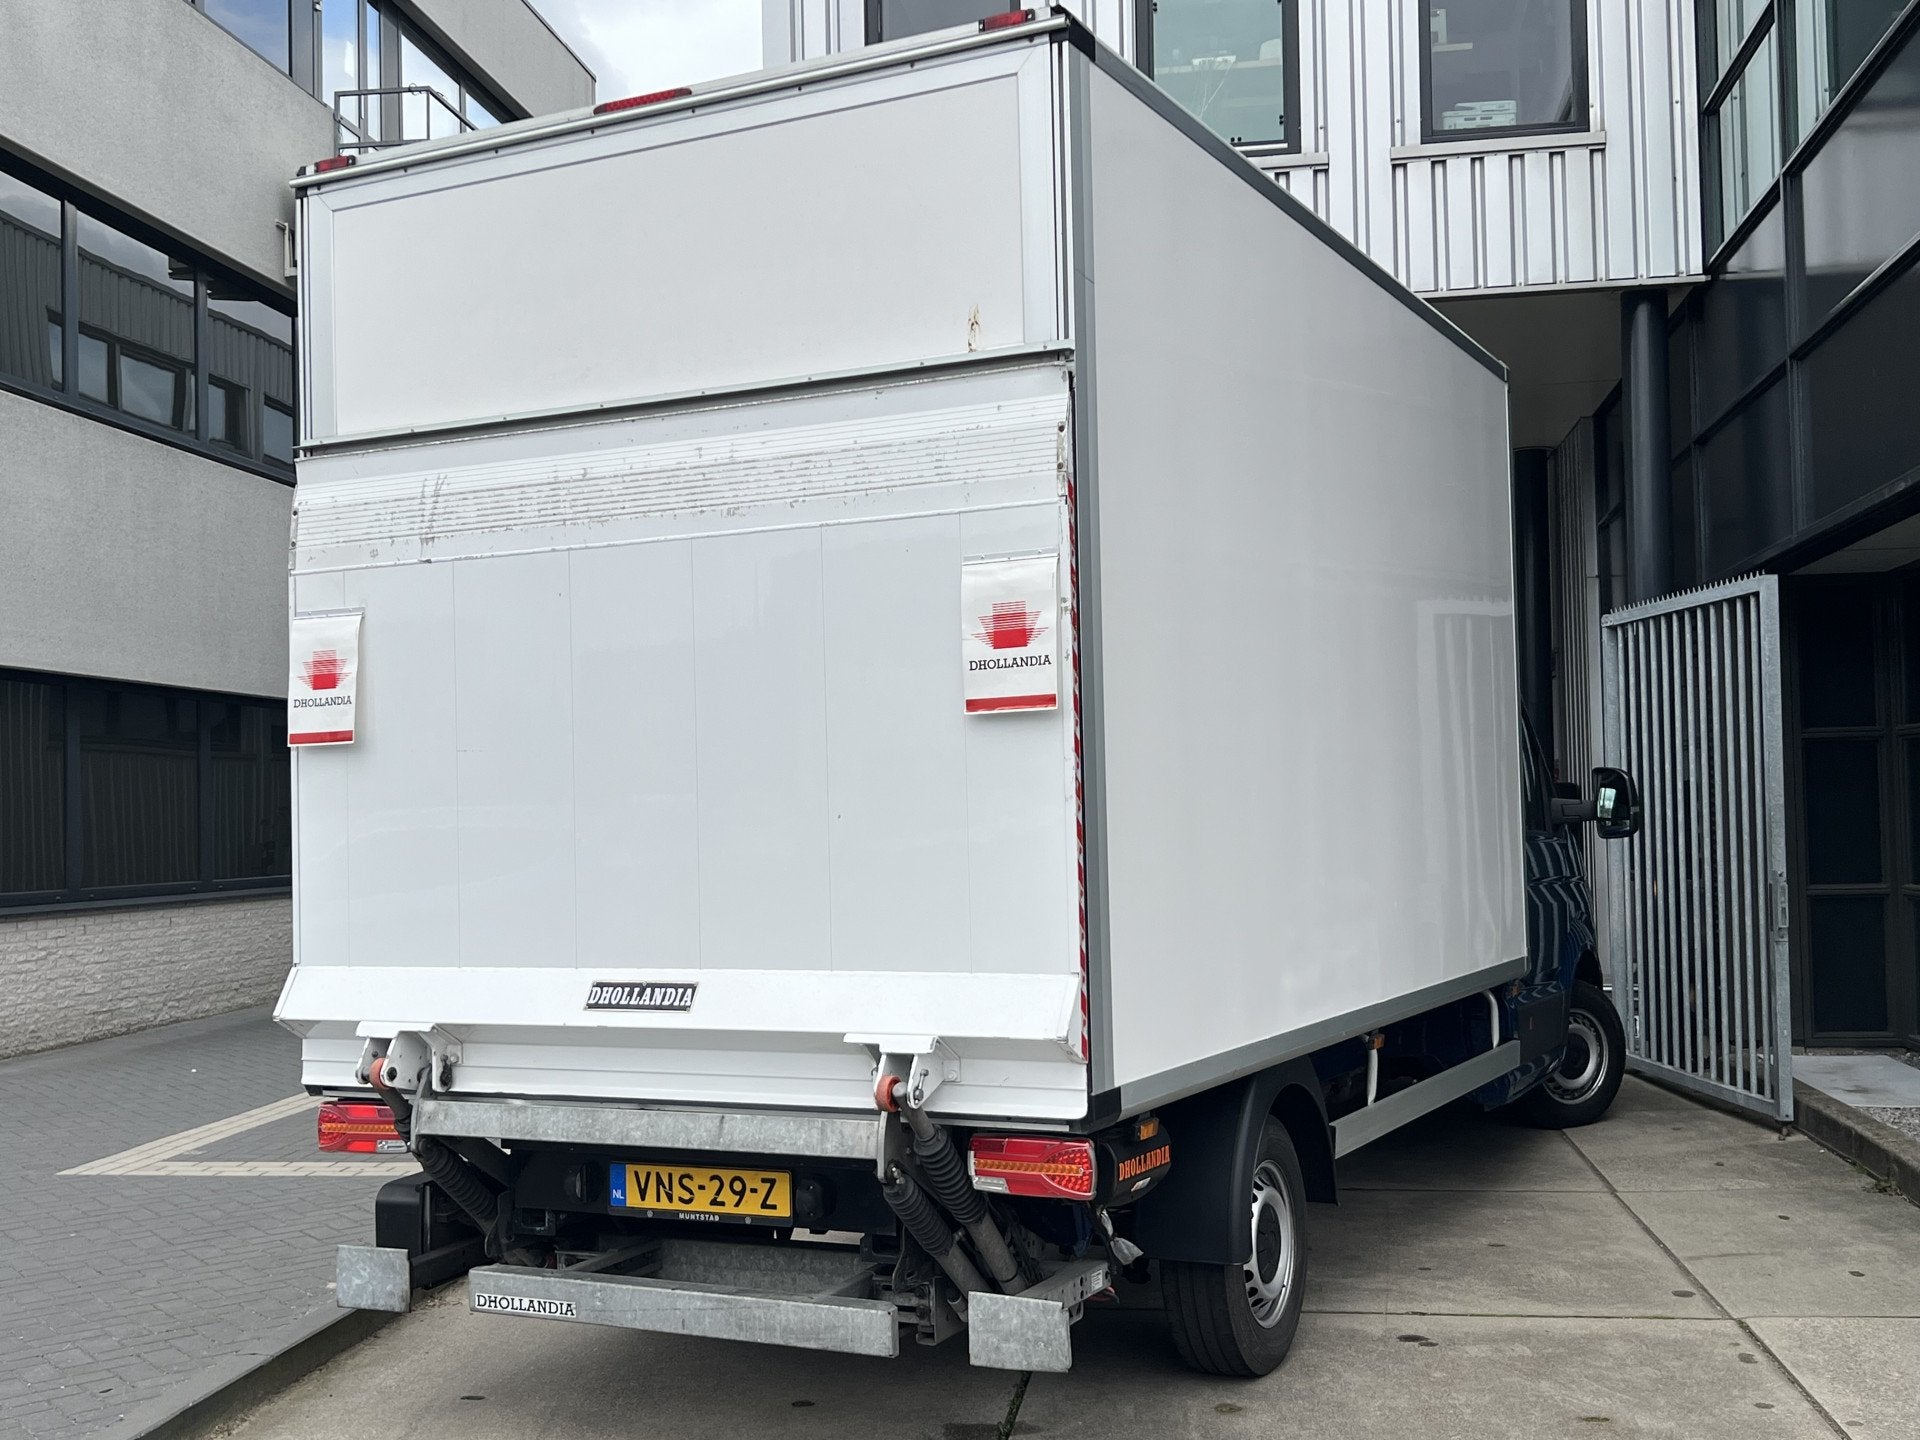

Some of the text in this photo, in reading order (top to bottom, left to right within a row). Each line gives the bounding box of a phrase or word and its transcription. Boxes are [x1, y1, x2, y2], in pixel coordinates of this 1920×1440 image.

[969, 654, 1052, 671] DHOLLANDIA
[293, 695, 352, 708] DHOLLANDIA
[587, 986, 693, 1006] DHOLLANDIA
[1119, 1145, 1170, 1181] DHOLLANDIA
[612, 1189, 625, 1199] NL
[634, 1170, 778, 1210] VNS-29-Z
[678, 1212, 720, 1221] MUNTSTAD
[476, 1294, 575, 1316] DHOLLANDIA
